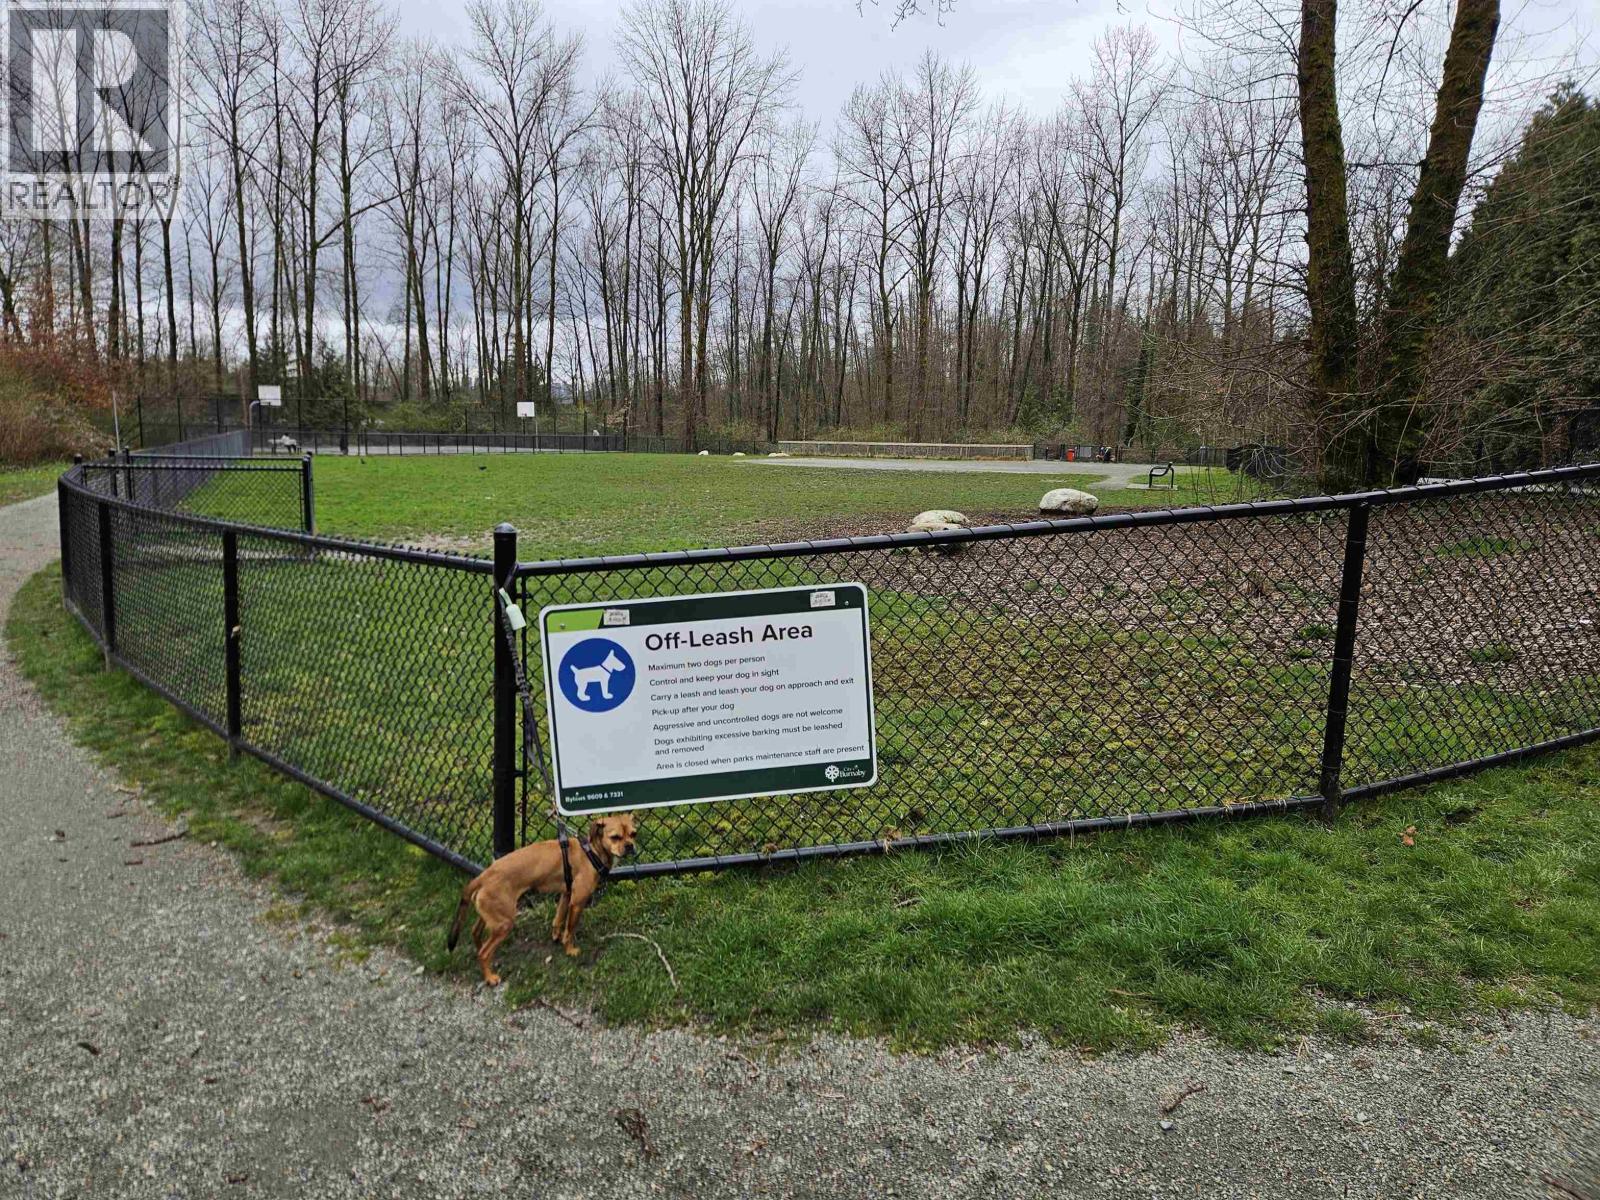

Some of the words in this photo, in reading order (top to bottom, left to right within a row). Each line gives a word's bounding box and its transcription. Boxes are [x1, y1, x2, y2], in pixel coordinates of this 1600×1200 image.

[645, 626, 753, 651] Off-Leash
[761, 624, 812, 641] Area
[647, 663, 686, 672] Maximum
[687, 661, 702, 669] two
[703, 659, 723, 668] dogs
[724, 658, 737, 667] per
[739, 655, 766, 665] person
[649, 677, 678, 687] Control
[679, 675, 694, 684] and
[695, 675, 715, 683] keep
[716, 673, 733, 683] your
[734, 671, 751, 680] dog
[751, 670, 759, 678] in
[760, 668, 780, 678] sight
[650, 694, 672, 702] Carry
[680, 690, 701, 699] leash
[702, 688, 717, 697] and
[718, 687, 739, 696] leash
[740, 686, 758, 695] your
[758, 684, 775, 693] dog
[775, 683, 786, 691] on
[787, 679, 823, 691] approach
[824, 678, 839, 687] and
[840, 677, 854, 685] exit
[651, 708, 680, 716] Pick-up
[681, 706, 699, 714] after
[700, 704, 718, 713] your
[719, 703, 735, 711] dog
[652, 721, 695, 732] Aggressive
[696, 719, 712, 727] and
[712, 714, 760, 726] uncontrolled
[760, 714, 780, 722] dogs
[781, 712, 794, 720] are
[795, 710, 809, 718] not
[809, 708, 843, 717] welcome
[654, 738, 675, 747] Dogs
[676, 734, 713, 744] exhibiting
[714, 730, 751, 740] excessive
[751, 727, 780, 737] barking
[781, 725, 801, 734] must
[813, 721, 843, 731] leashed
[655, 748, 670, 756] and
[671, 744, 705, 754] removed
[684, 758, 709, 768] closed
[710, 757, 732, 765] when
[733, 754, 754, 764] parks
[755, 751, 803, 761] maintenance
[804, 747, 821, 756] staff
[836, 745, 865, 755] present
